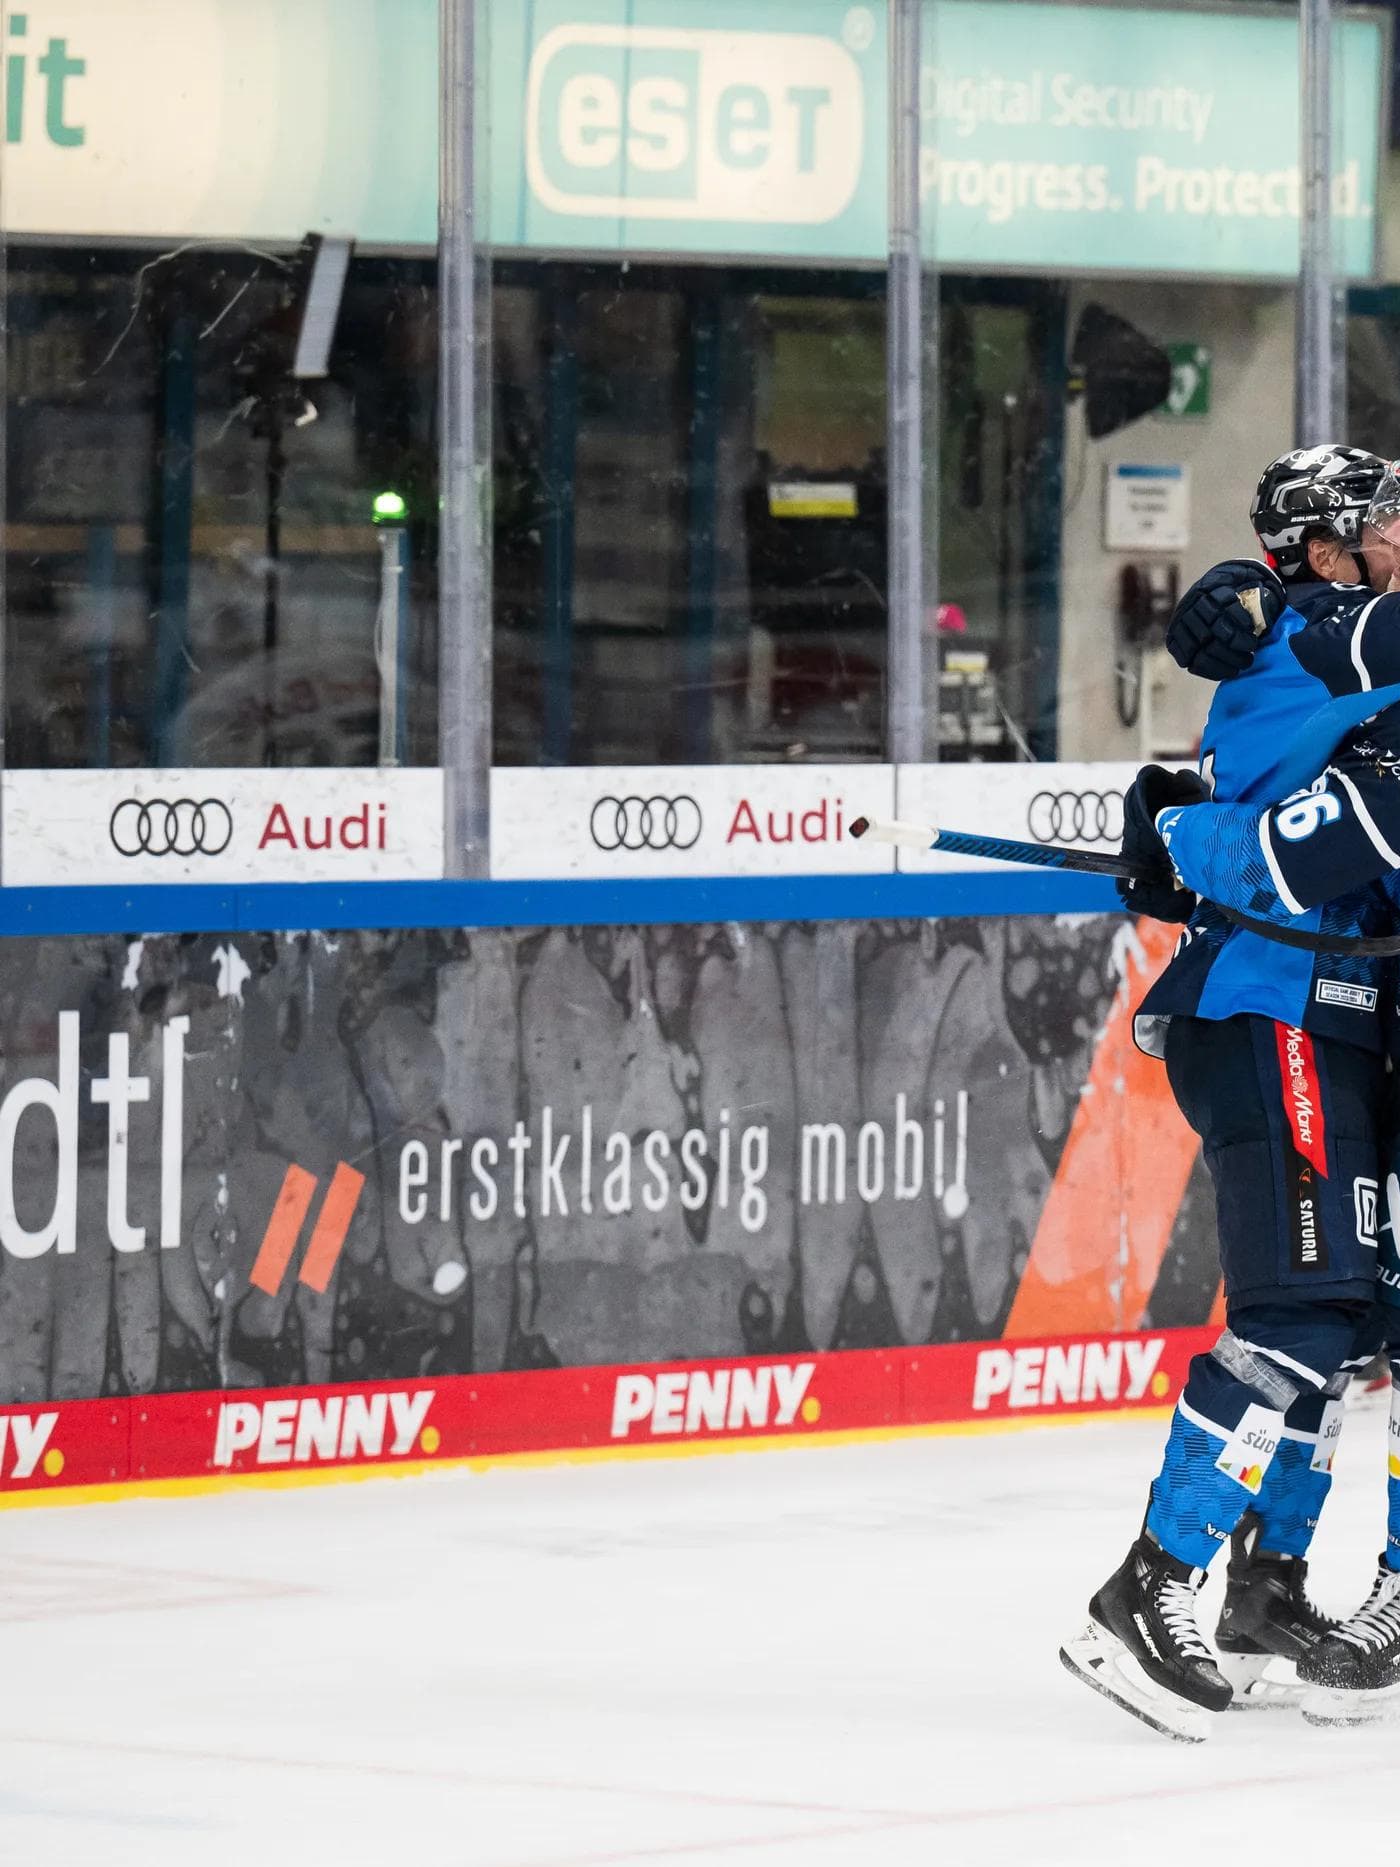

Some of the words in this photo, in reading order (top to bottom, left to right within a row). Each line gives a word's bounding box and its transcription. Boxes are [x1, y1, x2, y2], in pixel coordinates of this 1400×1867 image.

[920, 66, 1042, 137] Digital
[1050, 73, 1215, 144] Security
[919, 148, 1124, 225] Progress.
[1135, 155, 1375, 219] Protectd.
[258, 802, 388, 851] Audi
[726, 798, 843, 844] Audi
[398, 1104, 770, 1234] erstklassig
[1299, 1198, 1318, 1263] SATURN
